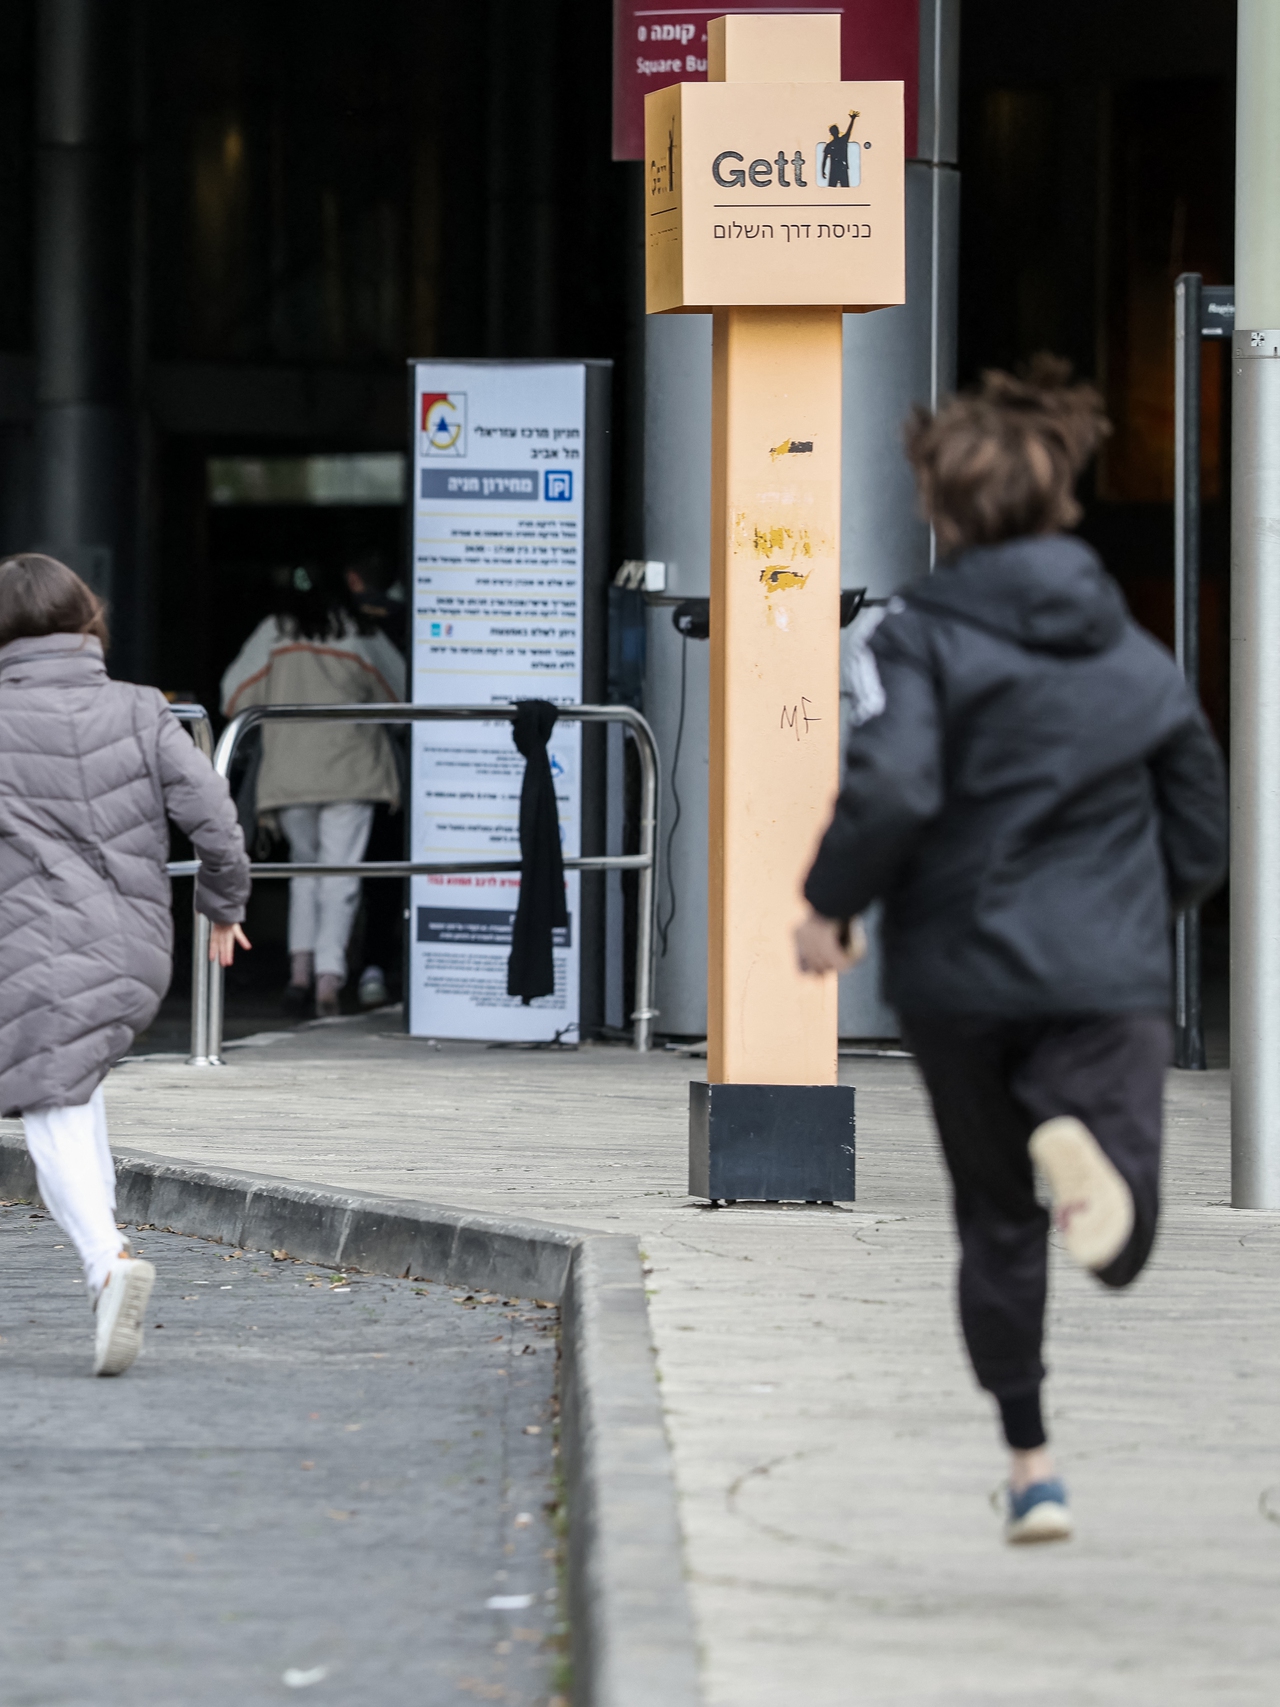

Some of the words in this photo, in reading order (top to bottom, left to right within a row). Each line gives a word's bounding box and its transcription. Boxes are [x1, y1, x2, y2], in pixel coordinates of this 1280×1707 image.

[650, 23, 696, 45] קומה
[636, 56, 682, 76] Square
[685, 54, 707, 73] Bu
[712, 150, 807, 188] Gett
[713, 221, 774, 239] השלום
[780, 223, 811, 242] דרך
[816, 223, 872, 239] כניסת
[474, 425, 517, 439] עזריאלי
[521, 428, 549, 439] מרכז
[553, 428, 580, 441] חניון
[531, 448, 558, 459] אביב
[562, 448, 580, 459] תל
[482, 476, 533, 496] מחירון
